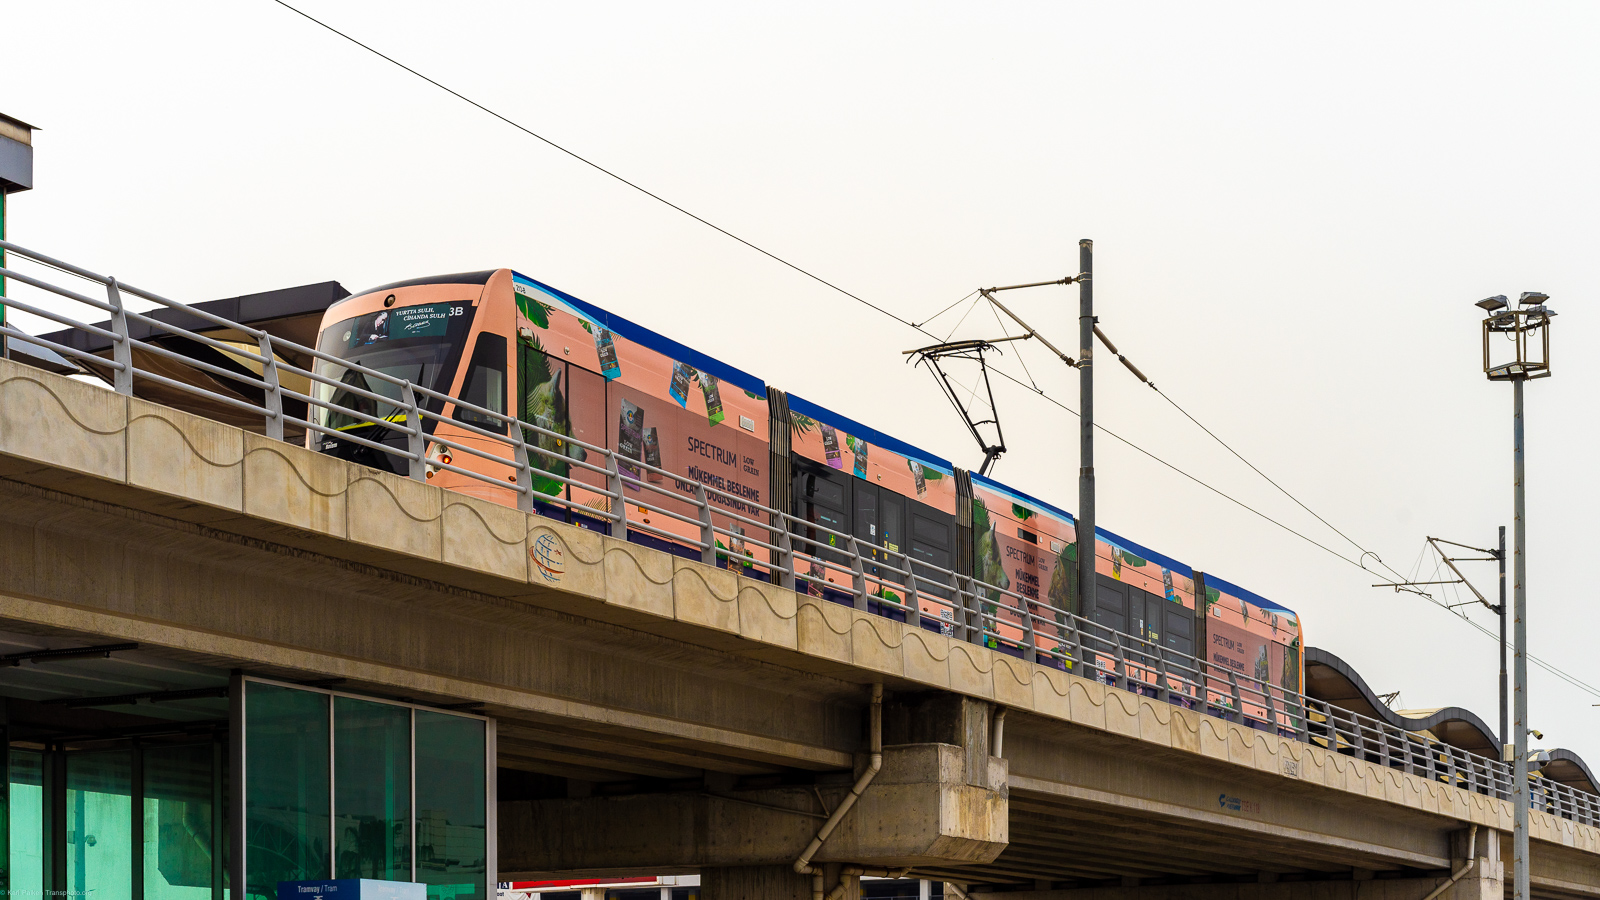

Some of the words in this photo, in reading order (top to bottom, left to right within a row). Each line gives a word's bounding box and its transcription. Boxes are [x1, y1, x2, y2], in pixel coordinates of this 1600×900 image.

[449, 306, 464, 316] 3B
[687, 436, 737, 468] SPECTRUM
[743, 455, 755, 466] LOW
[743, 465, 760, 477] GRAIN
[688, 465, 726, 490] MÜKEMMEL
[726, 479, 760, 502] BESLENME
[1006, 545, 1035, 566] SPECTRUM
[1015, 568, 1040, 587] MÜKEMMEL
[1016, 582, 1040, 600] BESLENME
[1213, 634, 1234, 650] SPECTRUM
[297, 885, 320, 894] Tramvay
[324, 884, 338, 892] Tram
